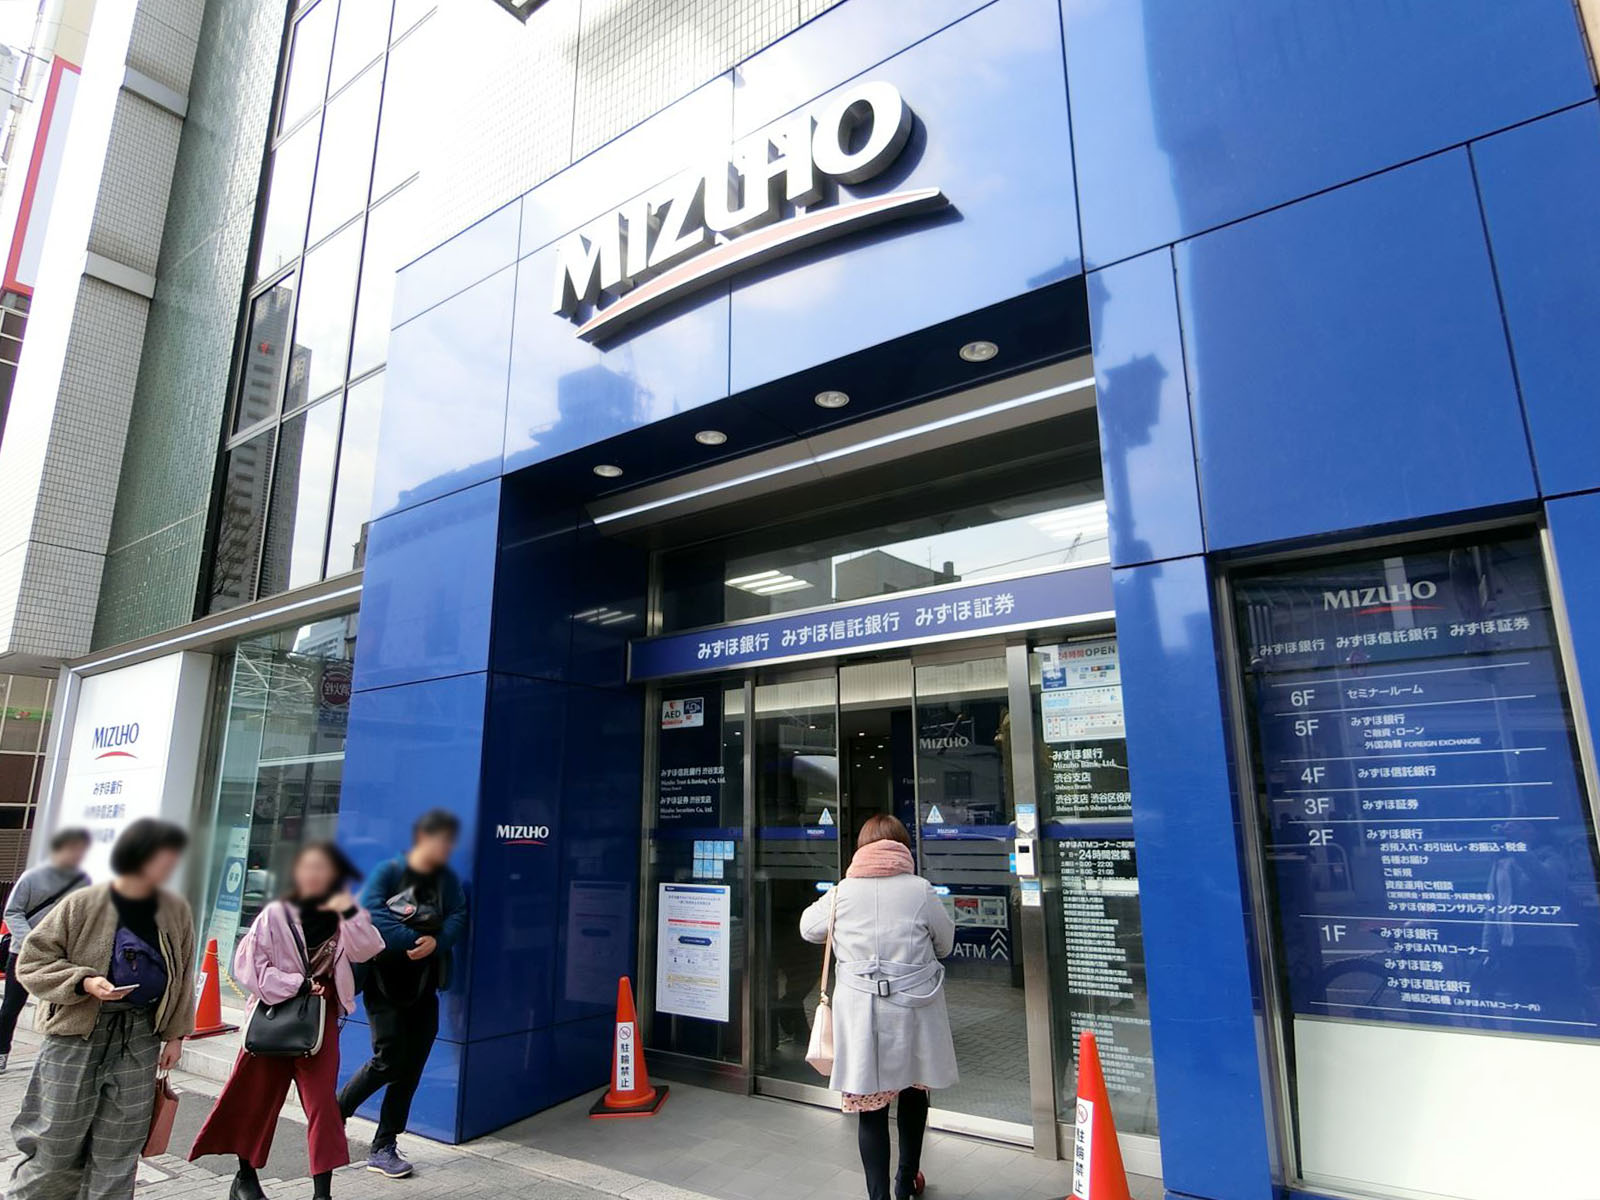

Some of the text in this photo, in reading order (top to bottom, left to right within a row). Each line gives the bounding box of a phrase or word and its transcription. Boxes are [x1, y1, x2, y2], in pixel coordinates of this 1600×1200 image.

[553, 81, 911, 318] MIZUHO
[1324, 581, 1437, 611] MIZUHO
[697, 594, 1015, 659] みずほ銀行 みずほ信託銀行 みずほ証券
[1259, 617, 1530, 656] みずほ銀行 みずほ信託銀行 みずほ証券
[1291, 690, 1316, 706] 6F
[1347, 684, 1424, 699] セミナールーム
[664, 709, 681, 719] AED
[1350, 713, 1405, 727] みずほ銀行
[92, 722, 139, 749] MIZUHO
[1294, 719, 1319, 737] 5F
[920, 736, 969, 750] MIZUHO
[1364, 737, 1402, 750] 外国為替
[1404, 739, 1437, 748] FOREIGN
[1052, 747, 1103, 760] みずほ銀行
[1053, 760, 1079, 769] Mizuho
[1358, 764, 1436, 779] みずほ信託銀行
[1054, 772, 1091, 783] 渋谷支店
[1301, 766, 1326, 784] 4F
[1055, 793, 1089, 804] 渋谷支店
[1362, 798, 1418, 810] みずほ証券
[1304, 798, 1330, 815] 3F
[496, 824, 549, 839] MIZUHO
[1309, 829, 1334, 847] 2F
[1366, 828, 1423, 840] みずほ銀行
[1078, 849, 1130, 861] 24時間営業
[1321, 925, 1347, 943] 1F
[1380, 927, 1439, 941] みずほ銀行
[953, 943, 987, 959] ATM
[1393, 941, 1489, 954] みずほATMコーナー
[1384, 957, 1444, 973] みずほ証券
[1387, 976, 1471, 994] みずほ信託銀行
